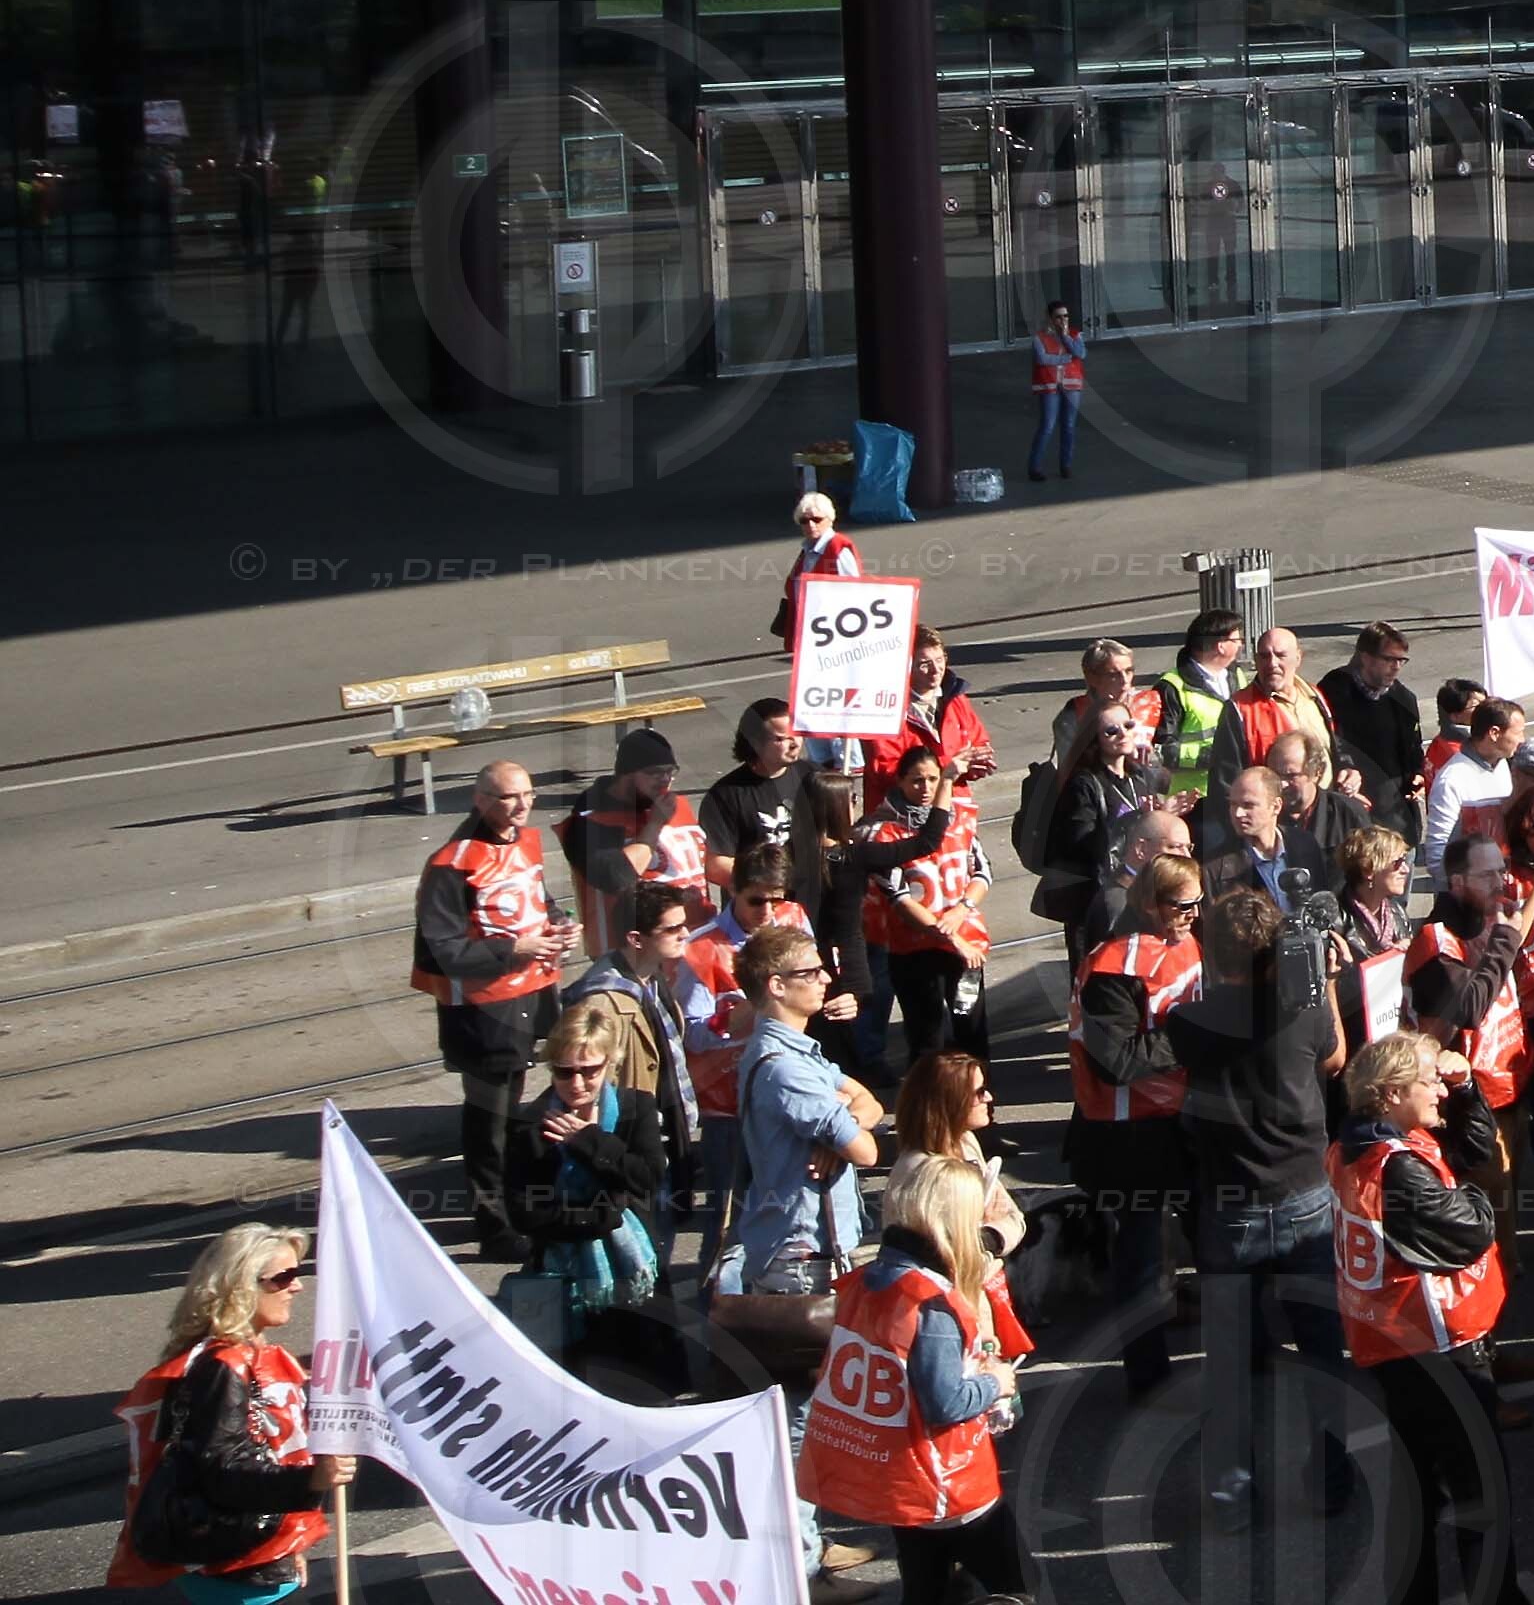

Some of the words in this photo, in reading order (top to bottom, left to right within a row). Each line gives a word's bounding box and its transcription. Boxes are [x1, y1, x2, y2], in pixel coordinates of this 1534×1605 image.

[811, 599, 893, 647] SOS
[817, 635, 903, 673] Journalismus
[829, 1341, 907, 1418] GB
